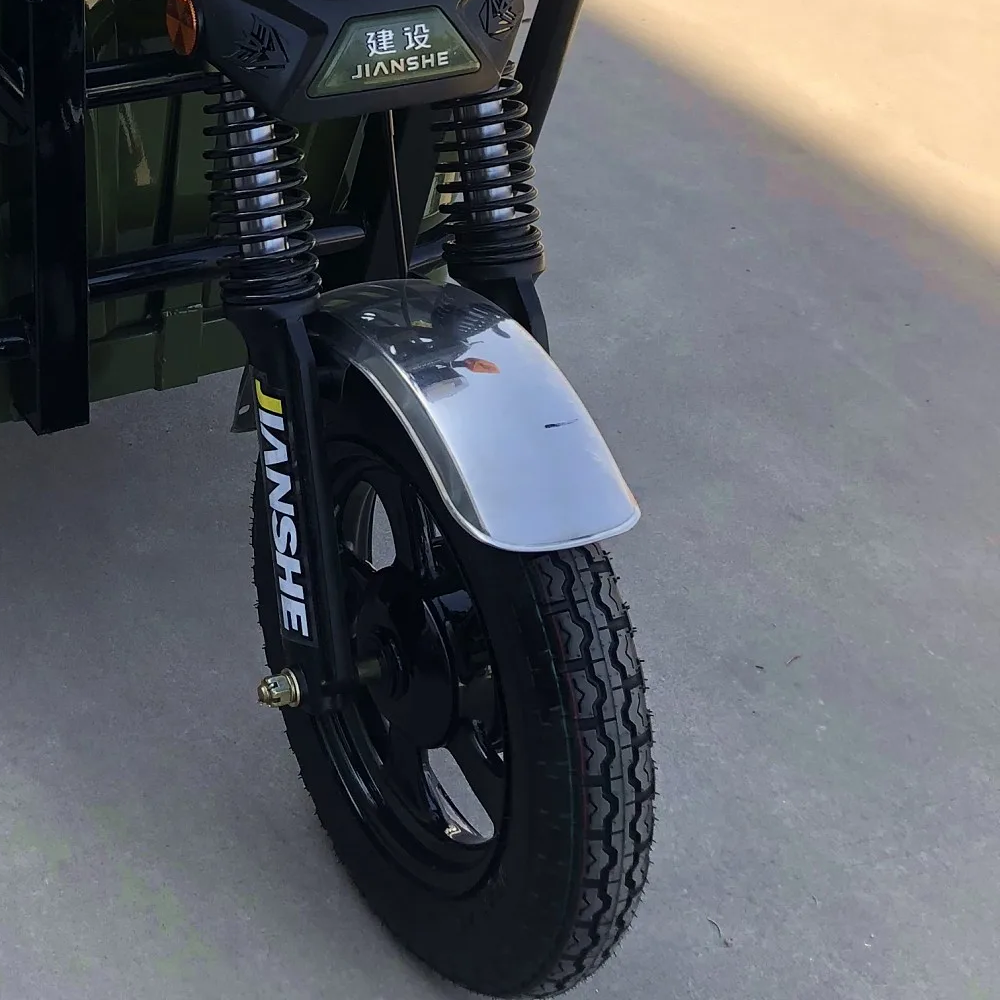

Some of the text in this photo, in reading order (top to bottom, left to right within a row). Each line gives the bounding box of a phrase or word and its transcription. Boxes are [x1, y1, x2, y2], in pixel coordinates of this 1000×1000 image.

[366, 23, 432, 57] 建设
[351, 51, 449, 80] JIANSHE
[255, 379, 309, 638] JIANSHE
